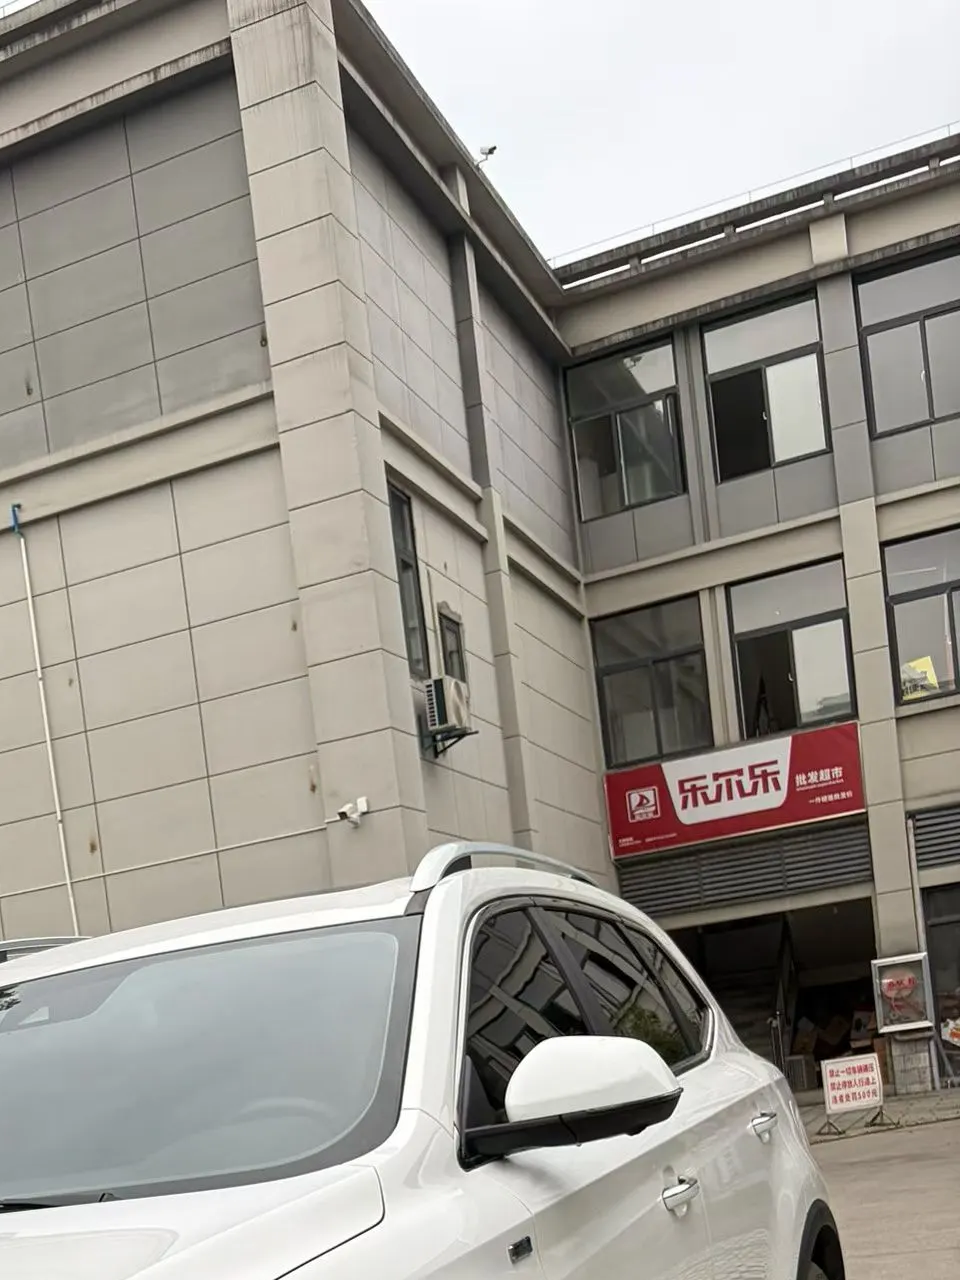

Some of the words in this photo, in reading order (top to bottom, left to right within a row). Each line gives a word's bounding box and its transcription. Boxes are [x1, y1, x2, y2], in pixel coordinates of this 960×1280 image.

[677, 760, 782, 811] 乐尔乐
[795, 766, 844, 787] 批发超市
